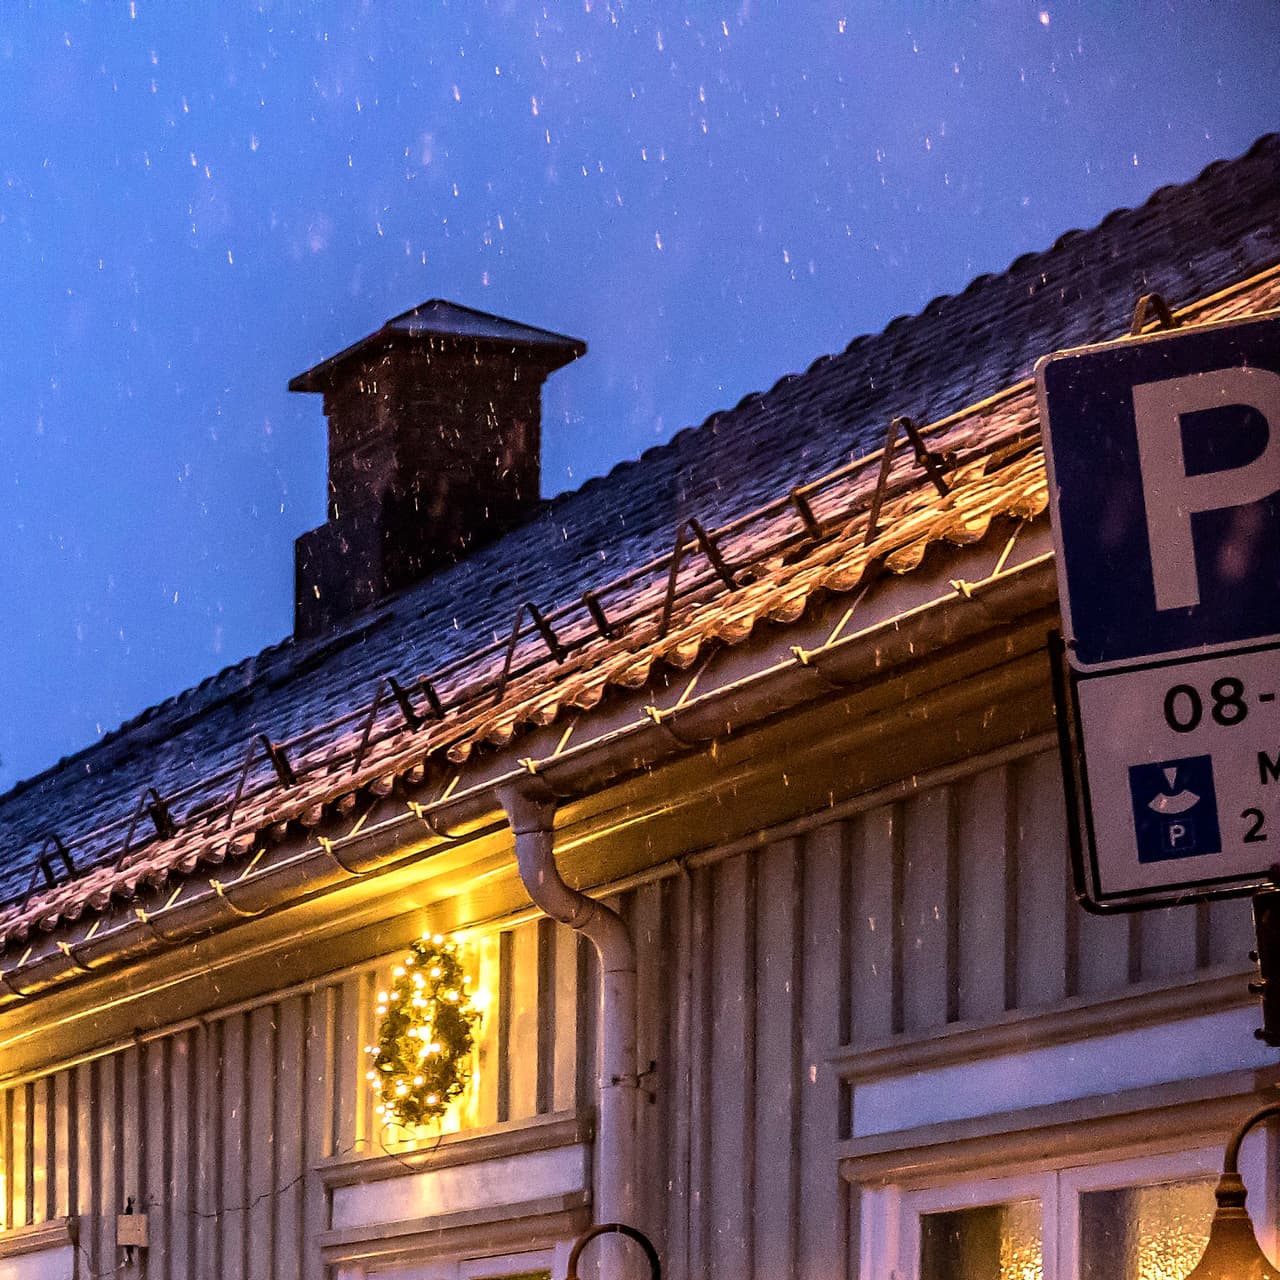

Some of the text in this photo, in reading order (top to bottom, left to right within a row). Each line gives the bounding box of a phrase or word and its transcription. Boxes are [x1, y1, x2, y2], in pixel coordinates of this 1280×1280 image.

[1133, 367, 1280, 611] P
[1164, 677, 1275, 733] 08-
[1169, 824, 1186, 847] P
[1240, 808, 1267, 843] 2
